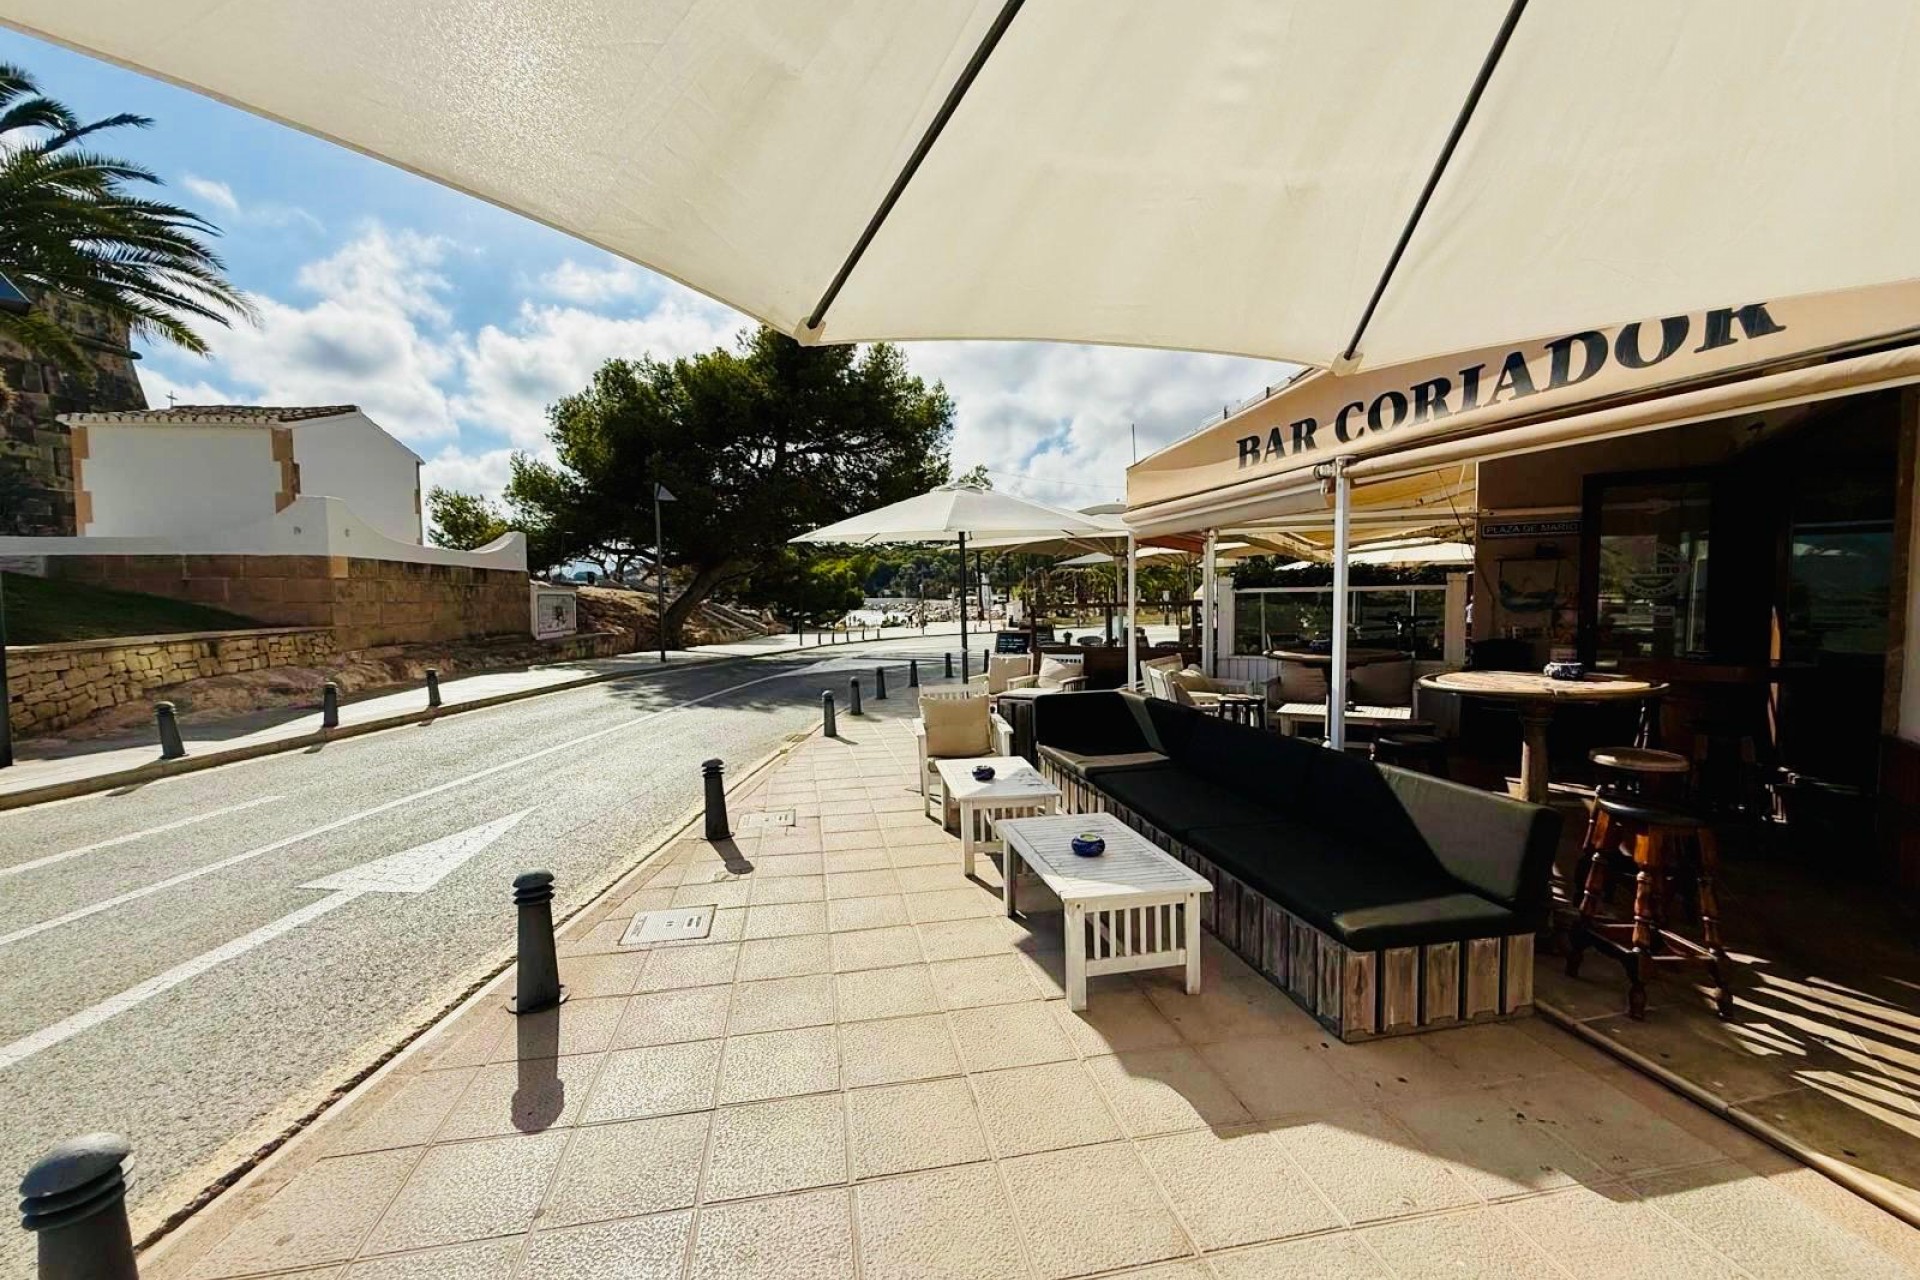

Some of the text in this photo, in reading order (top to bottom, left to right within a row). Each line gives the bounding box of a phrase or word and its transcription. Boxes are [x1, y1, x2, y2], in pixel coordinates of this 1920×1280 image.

[1236, 302, 1787, 469] BAR CORIADOR
[1485, 525, 1521, 535] PLAZA
[1523, 524, 1537, 534] DE
